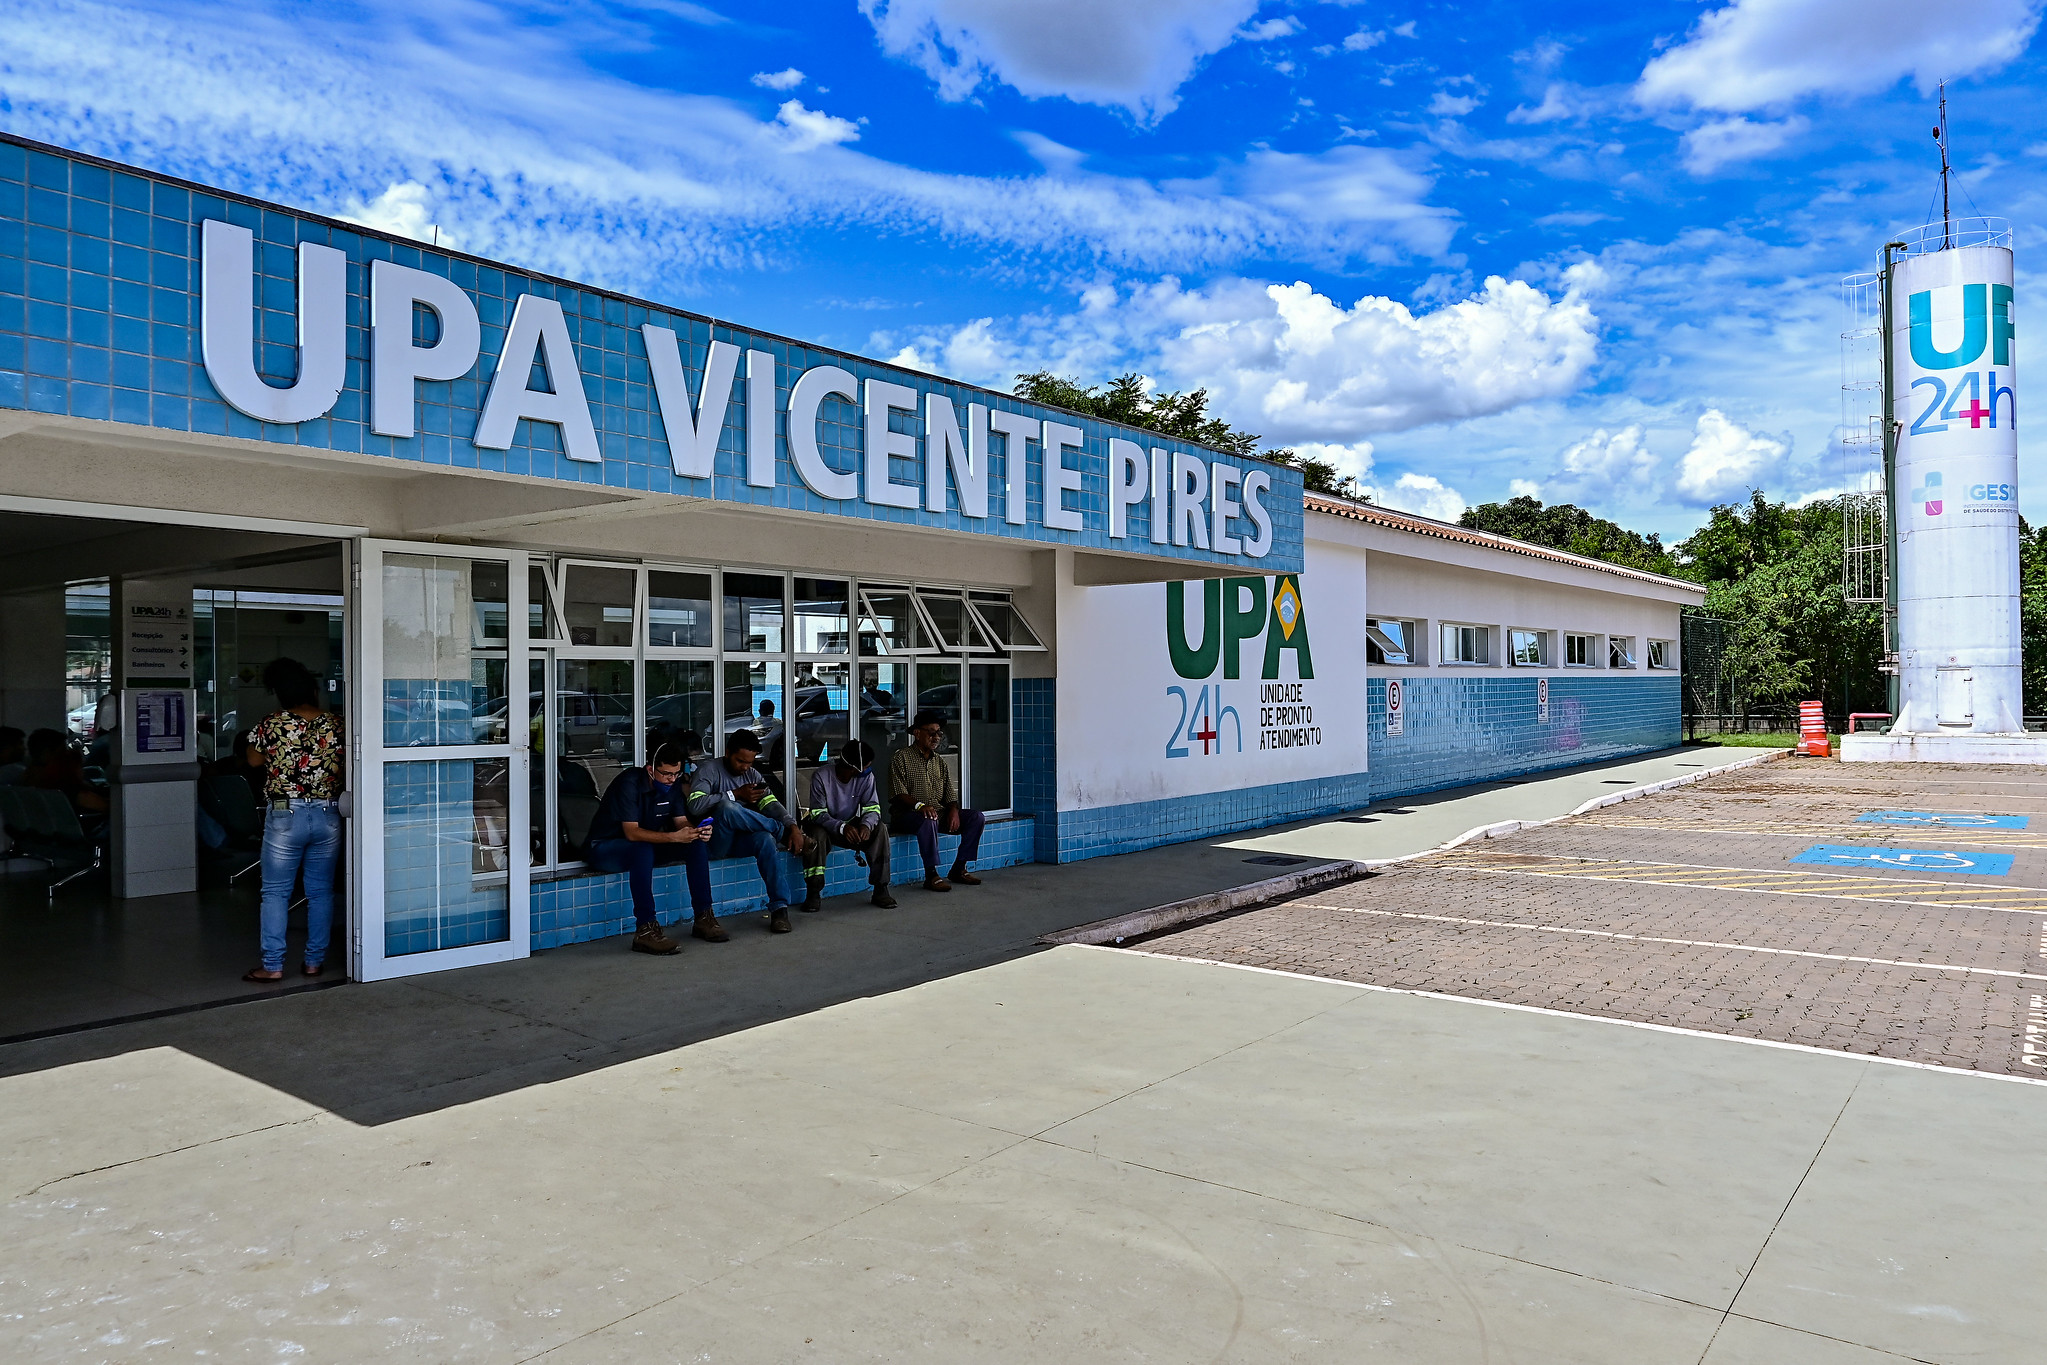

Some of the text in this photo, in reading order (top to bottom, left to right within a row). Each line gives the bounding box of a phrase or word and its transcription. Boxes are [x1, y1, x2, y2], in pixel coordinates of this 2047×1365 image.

[202, 218, 1273, 559] UPA VICENTE PIRES
[1910, 371, 2015, 436] 24h
[132, 632, 163, 640] Recepção
[1166, 574, 1314, 679] UPA
[132, 646, 174, 654] Consultórios
[1260, 683, 1303, 703] UNIDADE
[1165, 684, 1242, 758] 24h
[1260, 705, 1312, 727] DE PRONTO
[1259, 726, 1322, 750] ATENDIMENTO
